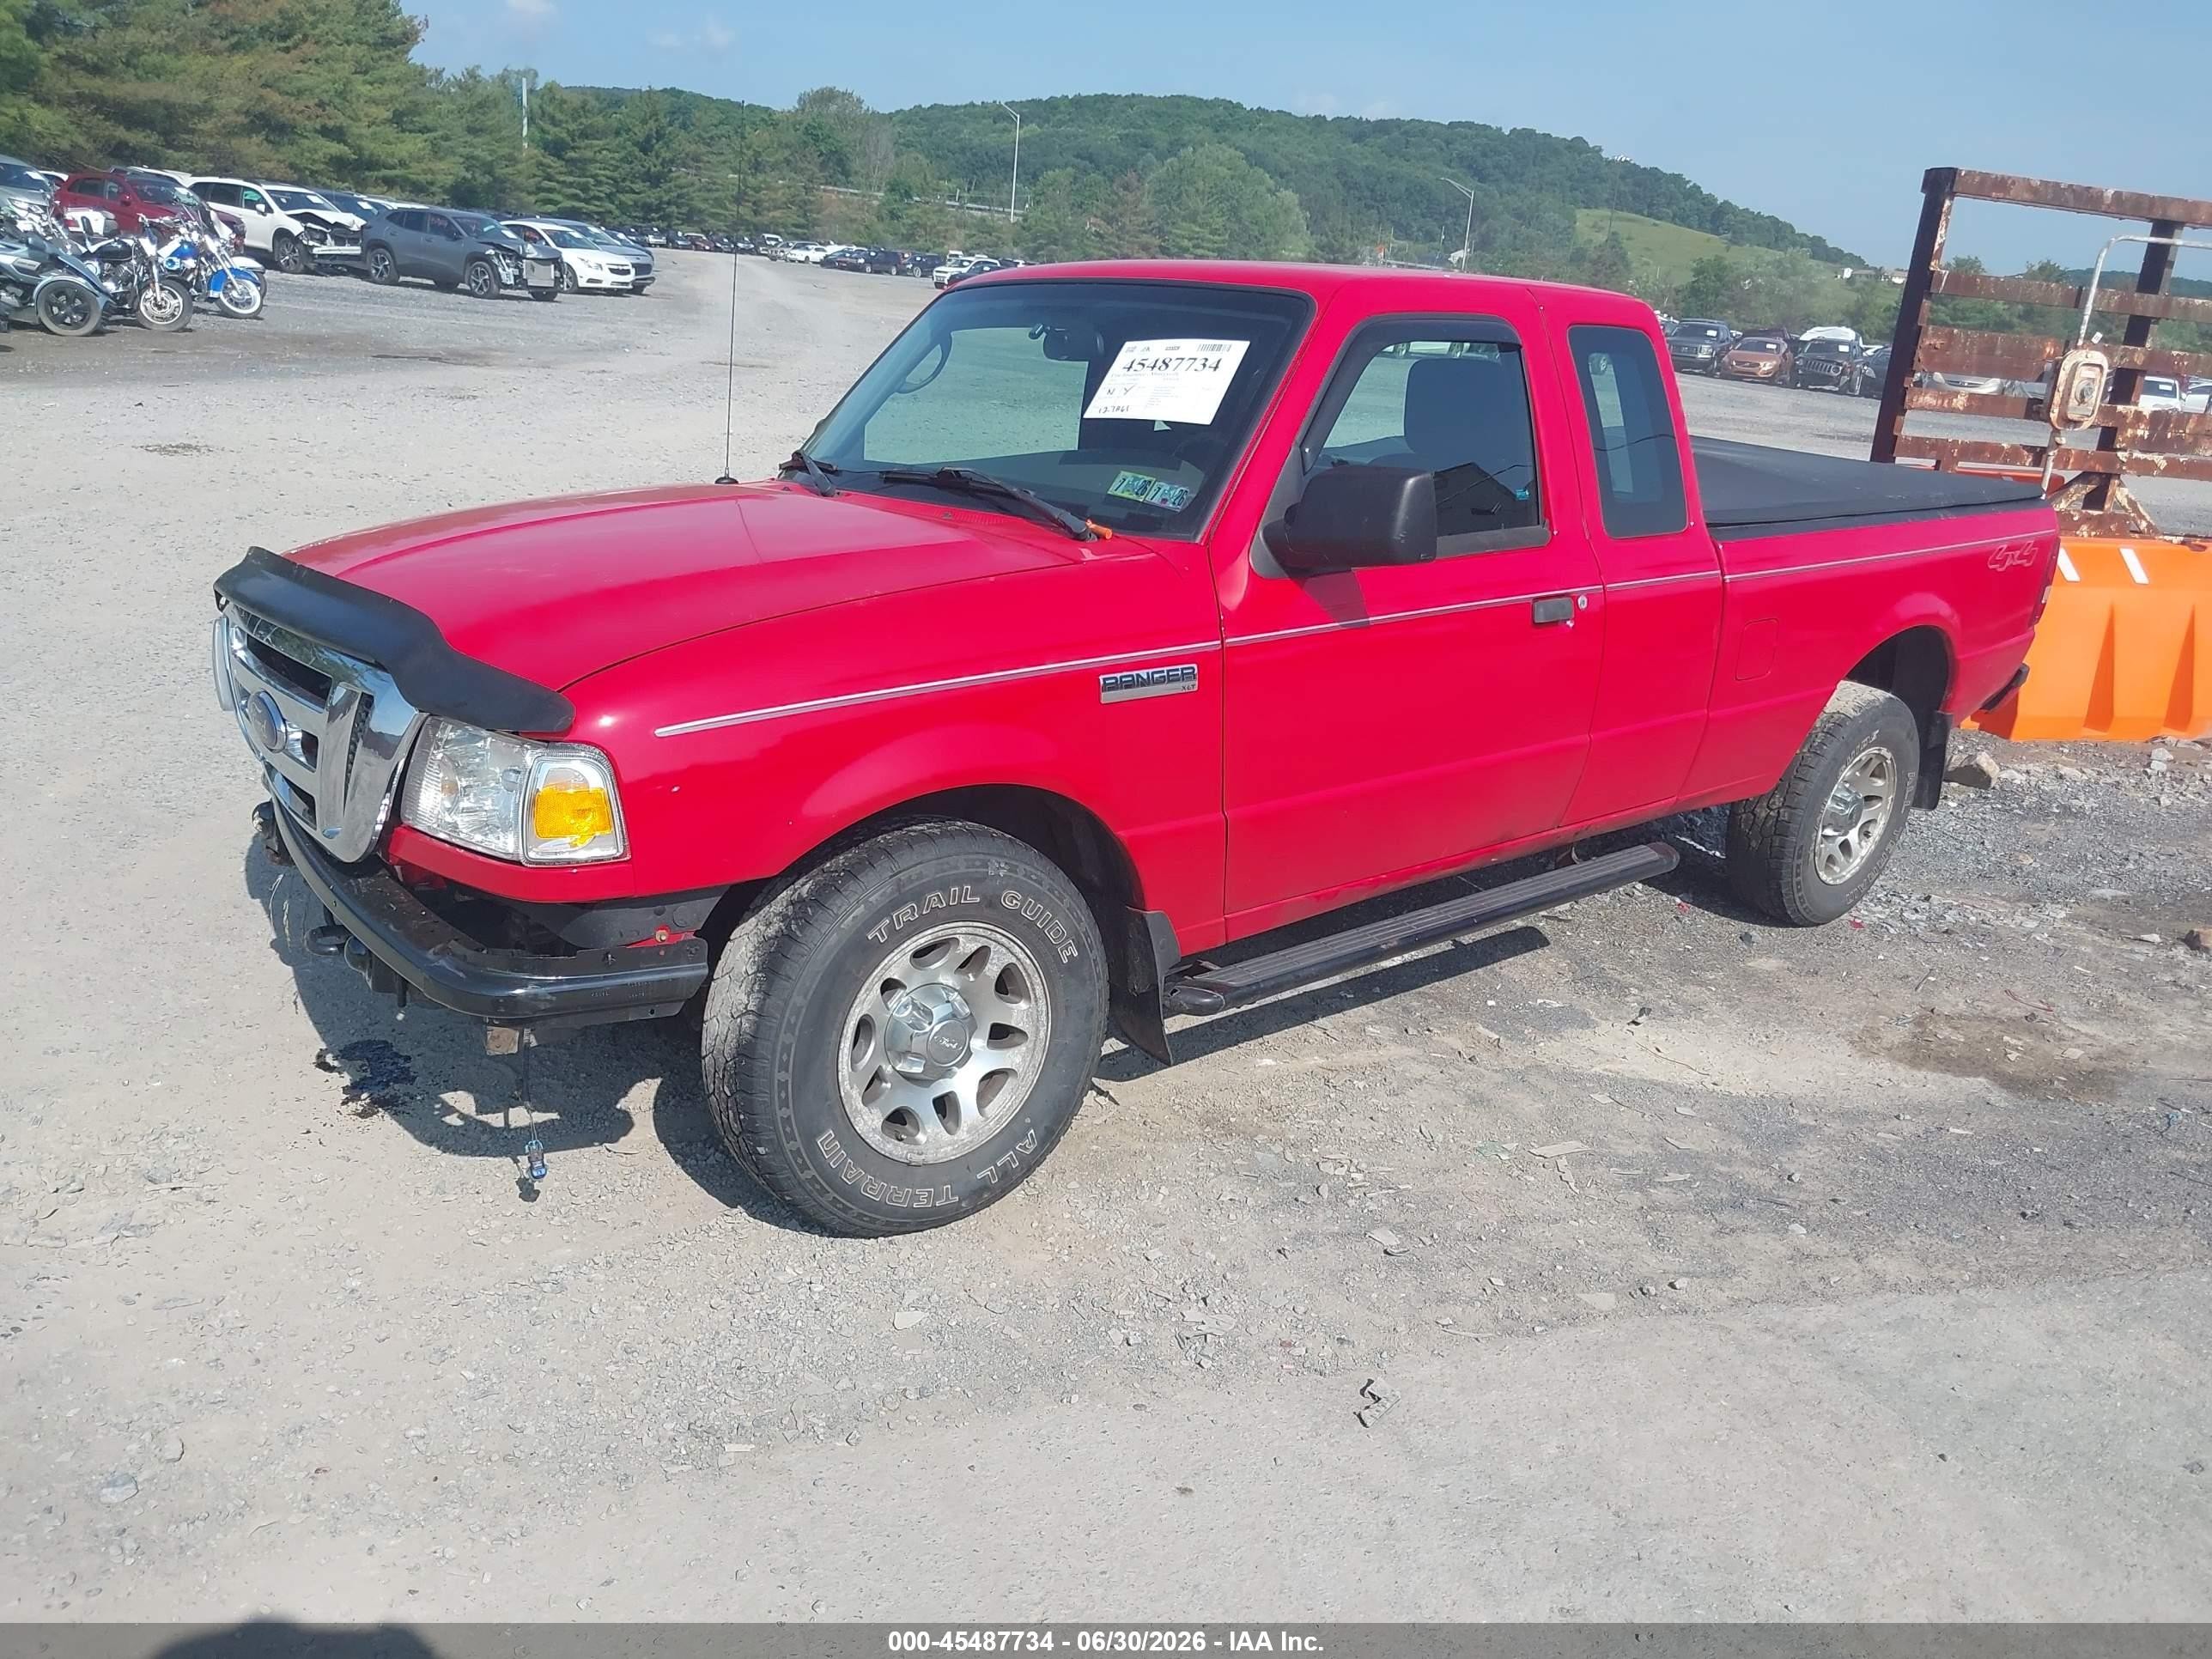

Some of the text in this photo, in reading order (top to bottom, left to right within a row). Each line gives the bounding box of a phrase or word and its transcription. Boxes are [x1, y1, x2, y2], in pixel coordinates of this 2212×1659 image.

[1122, 357, 1222, 372] 45487734
[1102, 665, 1197, 693] RANGER
[867, 885, 1079, 965] TRAIL GUIDE
[816, 1128, 1037, 1208] ALL TERRAIN
